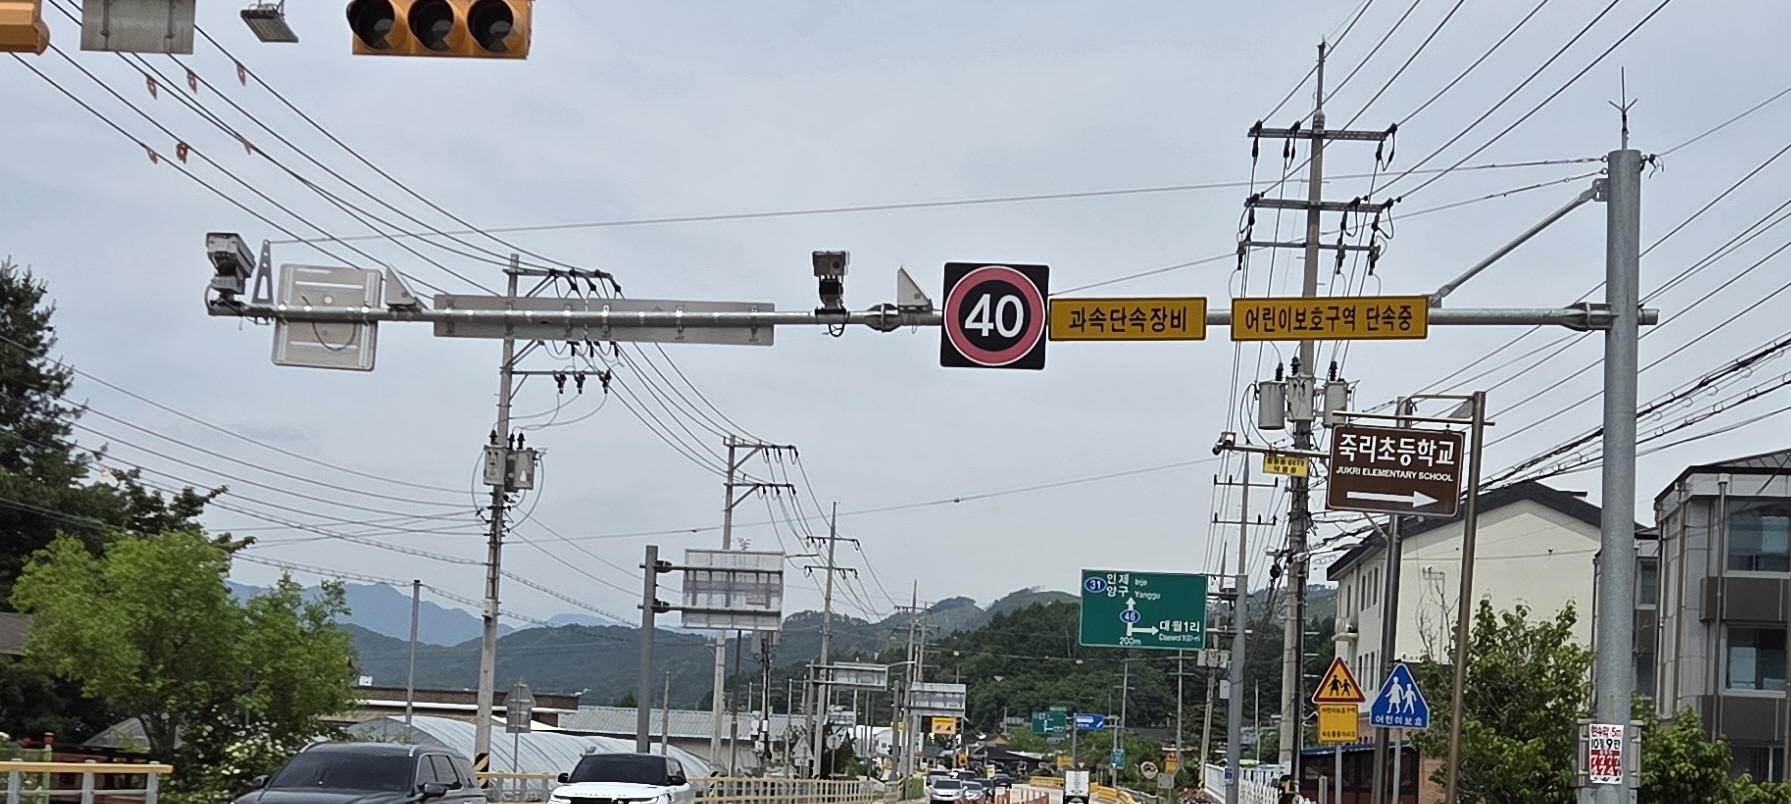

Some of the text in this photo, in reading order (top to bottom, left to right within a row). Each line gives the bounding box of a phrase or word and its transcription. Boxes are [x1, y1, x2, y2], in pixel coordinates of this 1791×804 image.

[964, 294, 1025, 338] 40
[1068, 306, 1187, 333] 과속단속장비
[1245, 305, 1412, 332] 어린이보호구역 단속중
[1338, 434, 1455, 467] 죽리초등학교
[1336, 466, 1454, 482] JUKRI ELEMENTARY SCHOOL
[1089, 580, 1101, 590] 31
[1107, 573, 1129, 585] 인제
[1107, 586, 1129, 597] 양구
[1134, 590, 1161, 600] Yanggu
[1124, 611, 1136, 620] 46
[1160, 620, 1200, 632] 대월1리
[1375, 715, 1423, 726] 어린이보호
